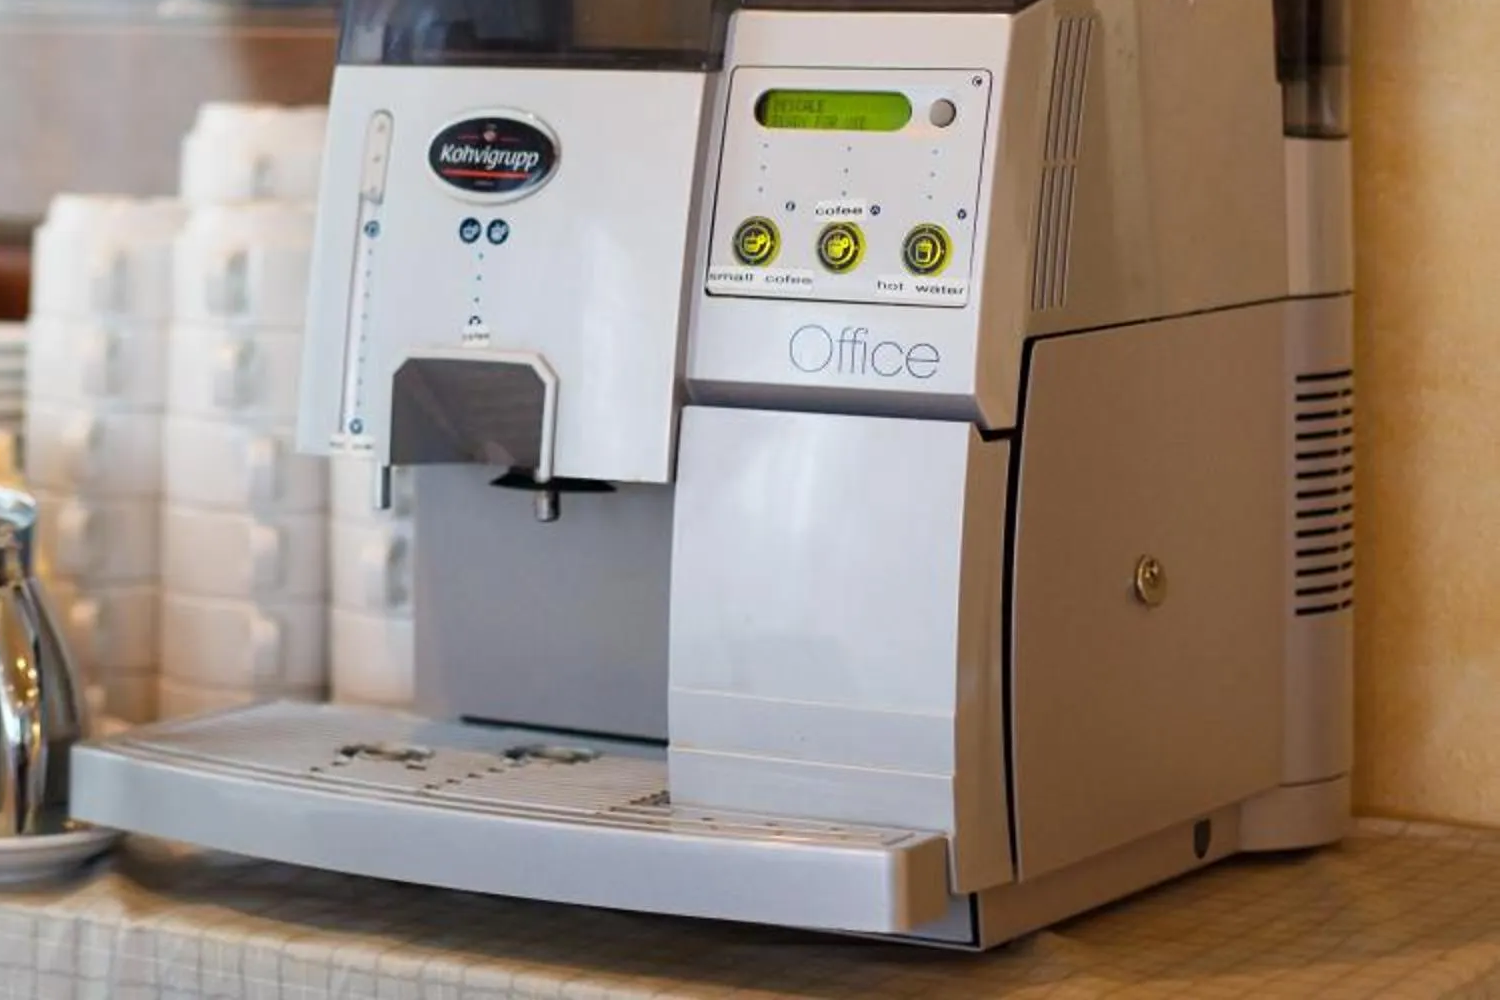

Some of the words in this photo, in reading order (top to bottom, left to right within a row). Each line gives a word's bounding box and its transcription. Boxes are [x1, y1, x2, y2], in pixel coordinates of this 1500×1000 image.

[440, 143, 540, 172] Kohvigrupp
[877, 279, 903, 291] hot
[915, 284, 965, 295] water
[789, 323, 941, 379] Office
